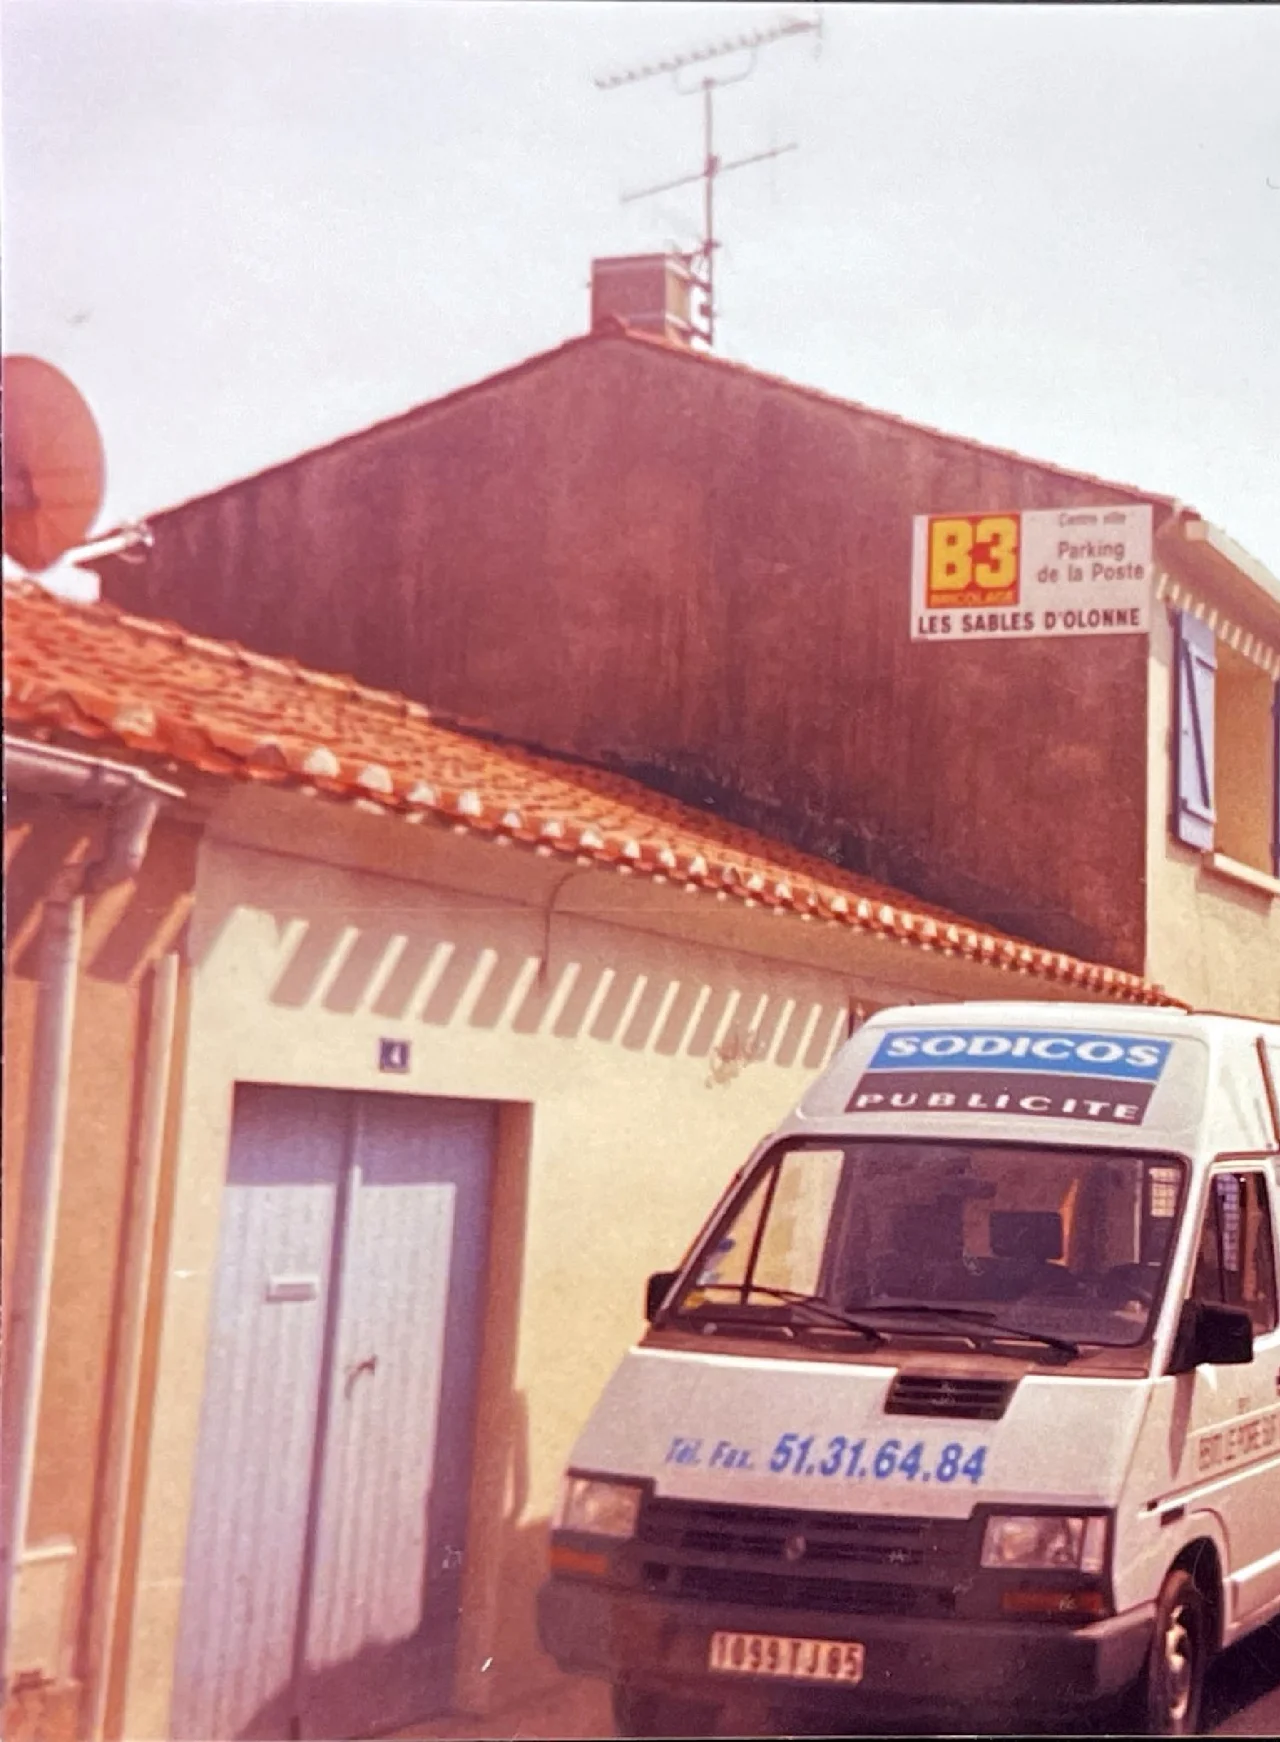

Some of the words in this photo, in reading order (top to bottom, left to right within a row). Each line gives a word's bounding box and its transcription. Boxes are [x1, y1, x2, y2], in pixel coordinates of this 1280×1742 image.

[931, 516, 1018, 590] B3
[1058, 541, 1125, 562] Parking
[1037, 564, 1059, 583] de
[1068, 563, 1084, 583] la
[1091, 562, 1145, 582] Poste
[918, 615, 952, 634] LES
[962, 611, 1035, 631] SABLES
[1044, 607, 1141, 629] D'OLONNE
[887, 1034, 1161, 1068] SODICOS
[855, 1092, 1142, 1121] PUBLICITE
[769, 1432, 989, 1485] 51.31.64.84
